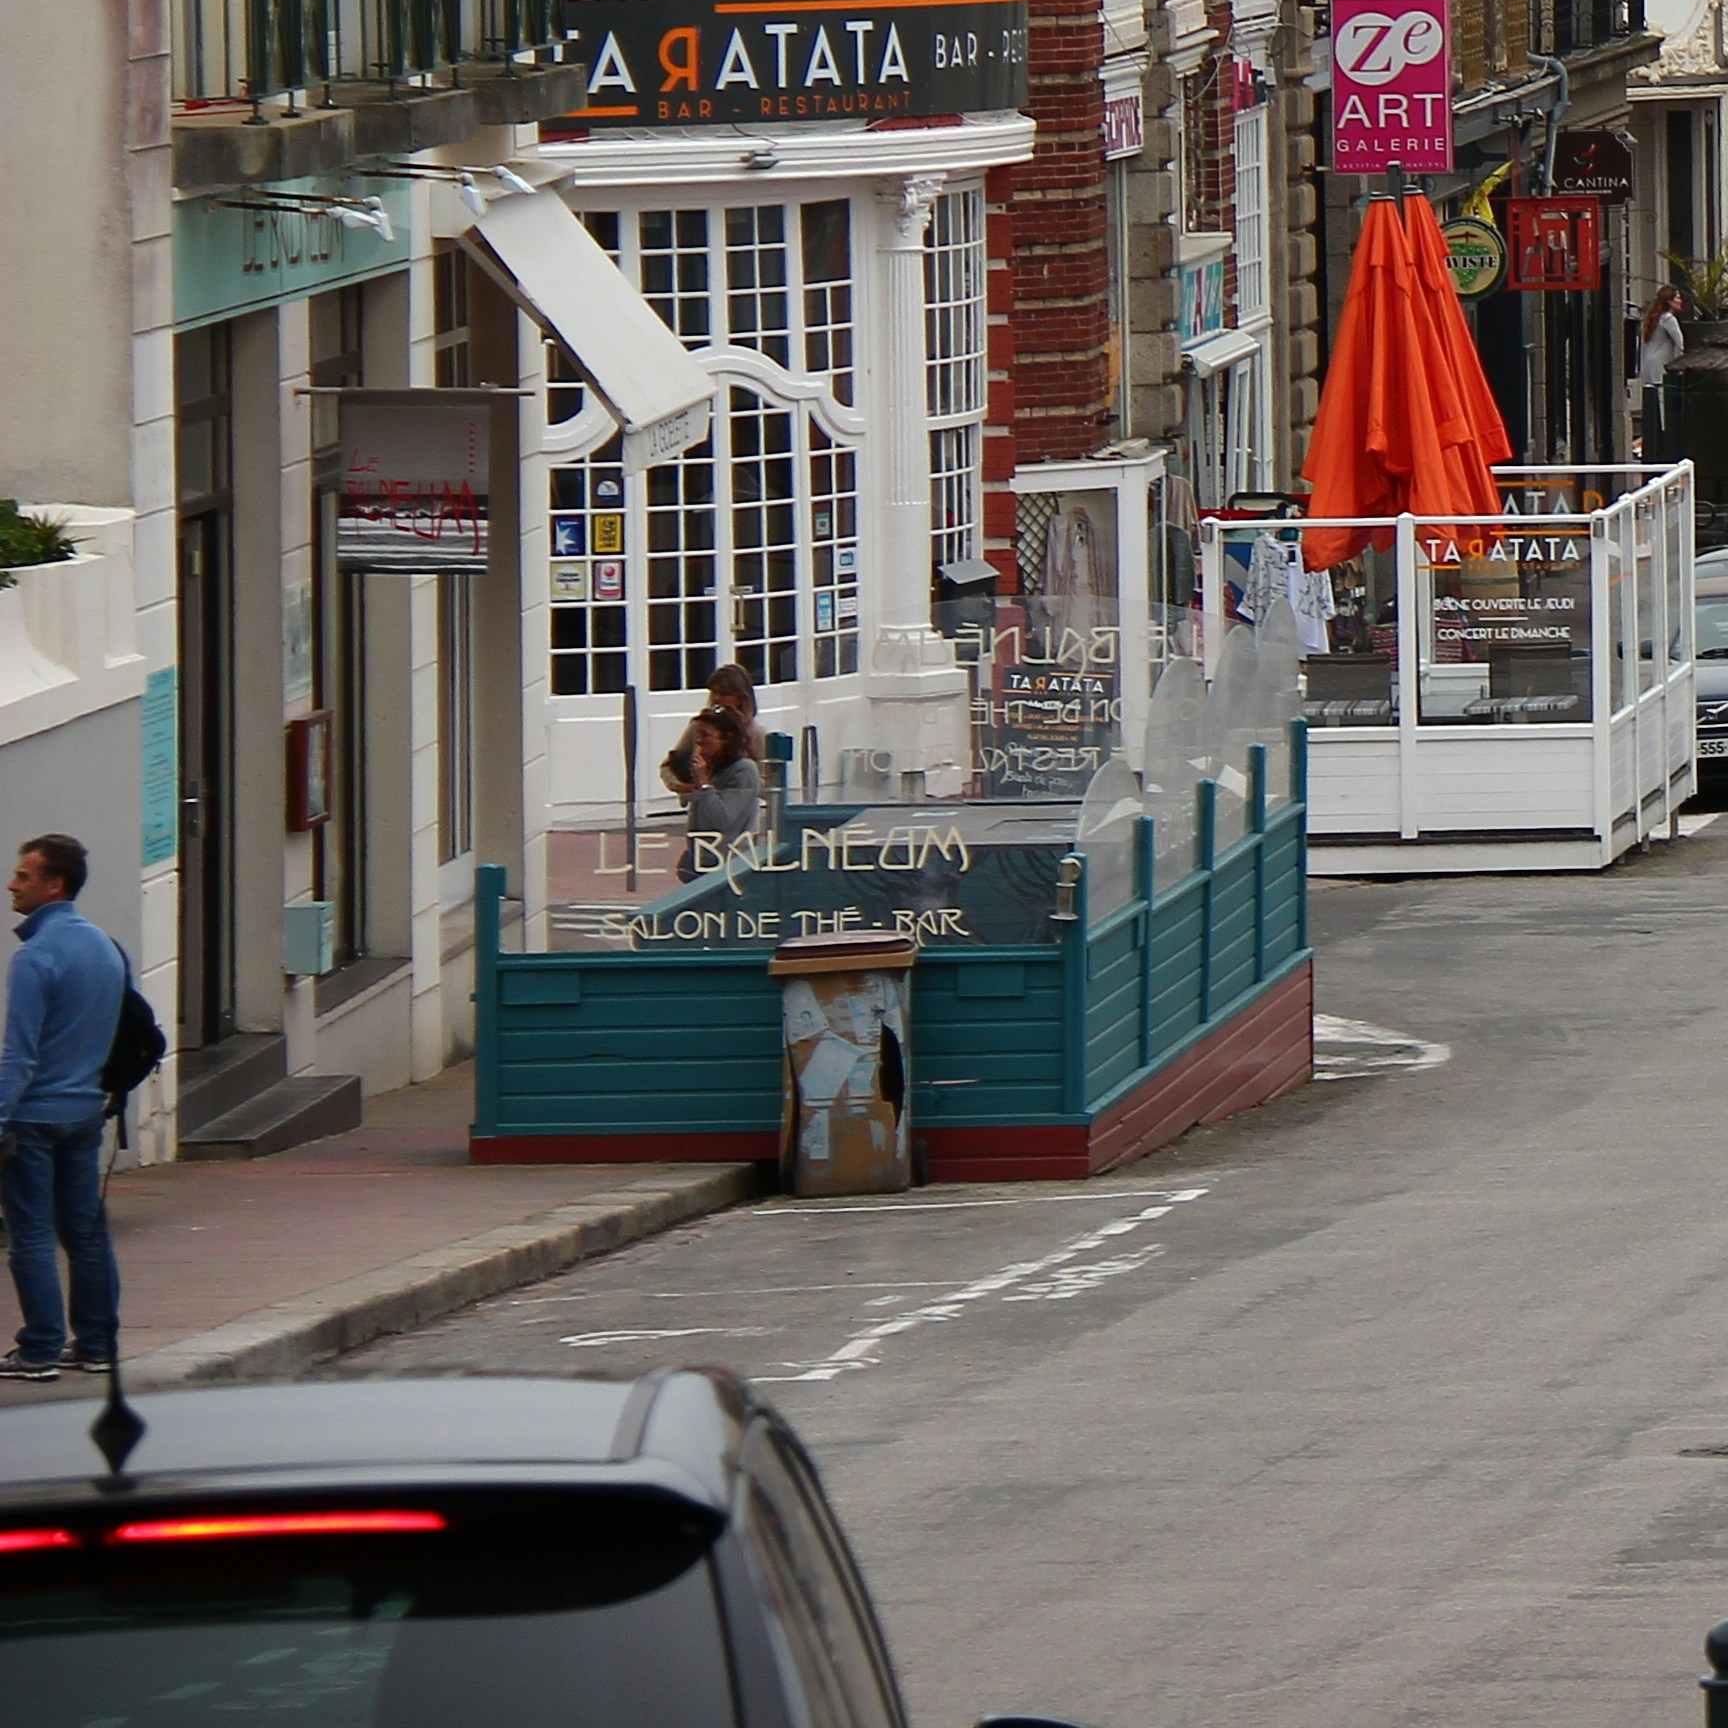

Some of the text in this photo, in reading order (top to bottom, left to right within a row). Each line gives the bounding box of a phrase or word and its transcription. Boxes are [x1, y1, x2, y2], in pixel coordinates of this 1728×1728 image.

[553, 19, 911, 95] ARATATA
[935, 33, 978, 70] BAR
[657, 101, 713, 120] BAR
[761, 91, 911, 116] RESTAURANT
[1336, 93, 1444, 129] ART
[1336, 137, 1445, 152] GALERIE
[1563, 176, 1629, 189] CANTINA
[1471, 598, 1526, 611] OUVERTE
[1527, 598, 1541, 610] LE
[1543, 597, 1575, 610] JEUDI
[1437, 626, 1571, 641] CONCERT LE DIMANCHE
[594, 823, 970, 897] LE BALNÉUM
[600, 910, 727, 952] SALON
[736, 911, 781, 939] DE
[791, 906, 863, 936] THÉ
[891, 908, 971, 947] BAR
